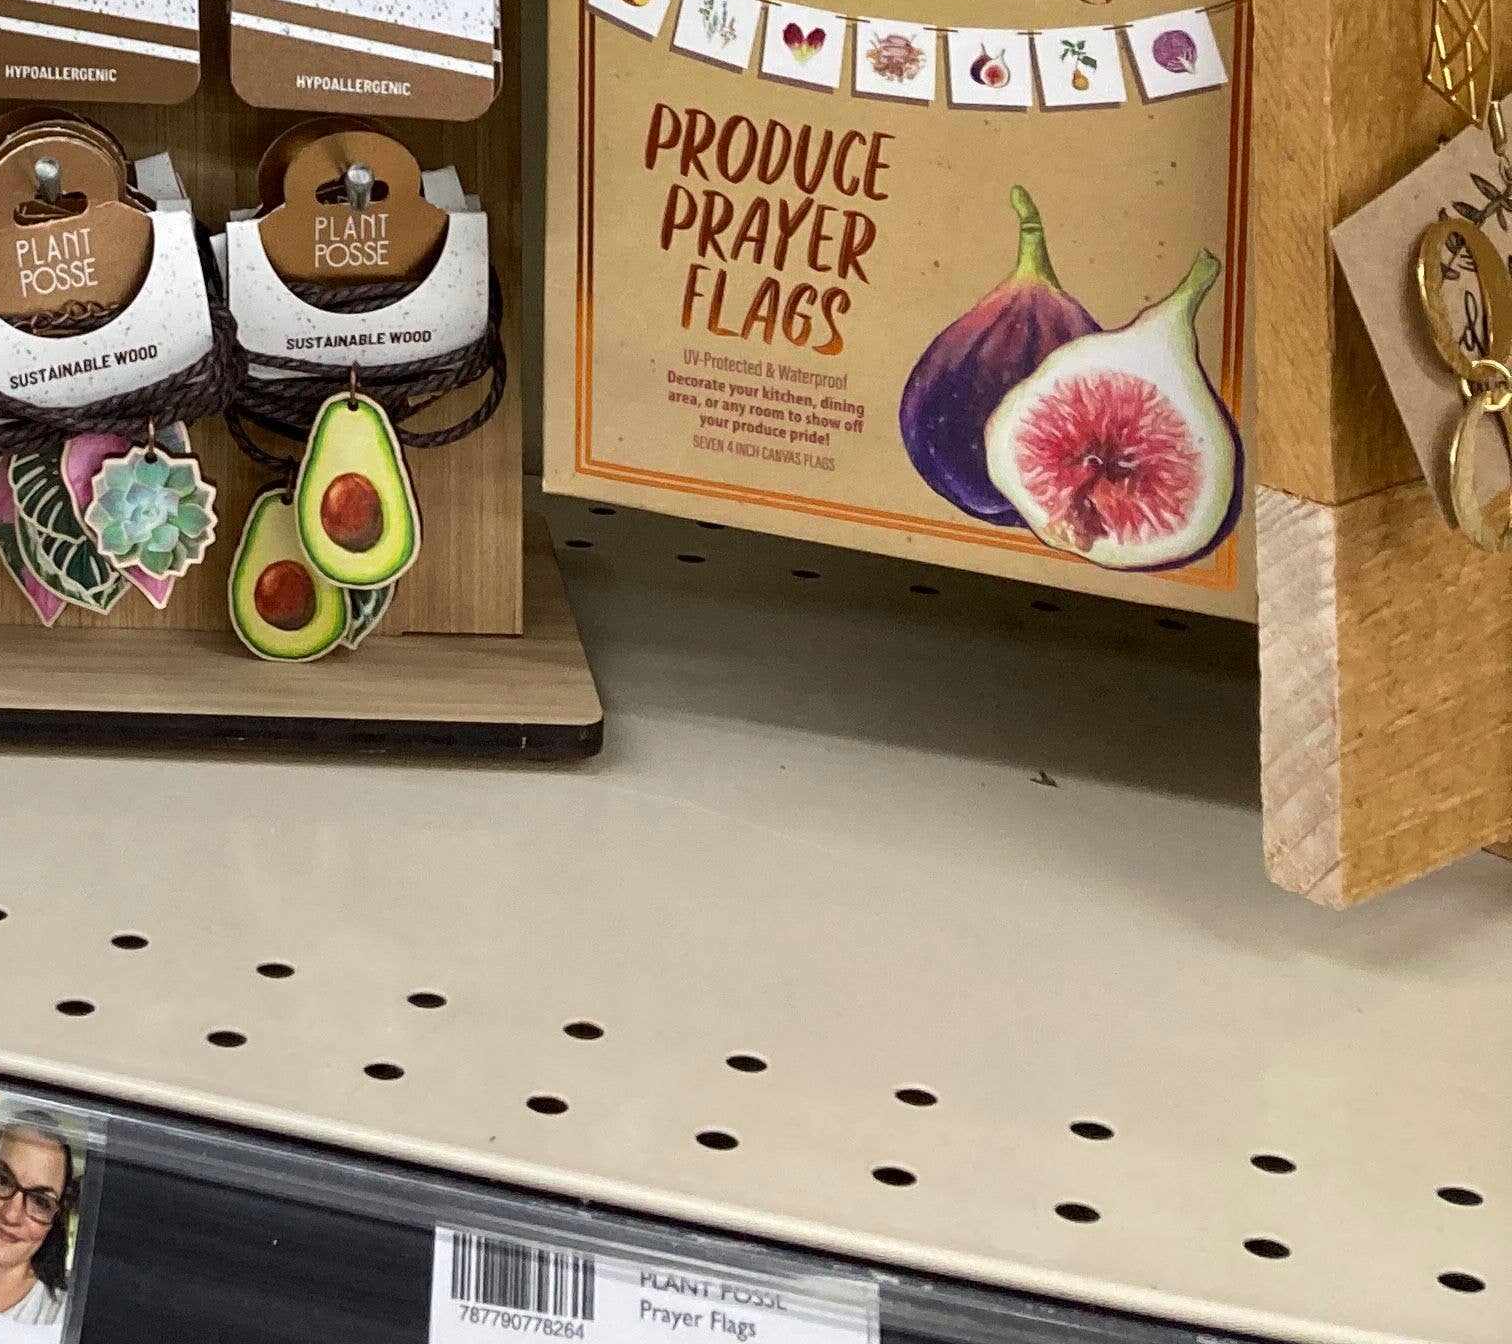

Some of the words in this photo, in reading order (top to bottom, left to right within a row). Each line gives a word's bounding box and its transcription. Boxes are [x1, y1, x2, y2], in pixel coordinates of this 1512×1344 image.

[4, 64, 118, 82] HYPOALLERGENIC
[295, 74, 412, 96] HYPOALLERGENIC
[644, 102, 897, 201] PRODUCE
[15, 228, 92, 266] PLANT
[315, 213, 390, 242] PLANT
[660, 183, 878, 285] PRAYER
[315, 240, 390, 268] POSSE
[20, 258, 100, 297] POSSE
[679, 263, 852, 356] FLAGS
[286, 332, 386, 351] SUSTAINABLE
[389, 329, 432, 345] WOOD
[9, 361, 112, 390] SUSTAINABLE
[114, 344, 159, 369] WOOD
[683, 348, 763, 378] UV-Protected
[765, 362, 776, 379] &
[777, 364, 849, 392] Waterproof
[666, 369, 727, 394] Decorate
[728, 383, 760, 401] your
[761, 385, 818, 410] kitchen,
[819, 396, 866, 419] dining
[667, 389, 702, 409] area,
[704, 396, 719, 409] or
[721, 400, 746, 417] any
[748, 405, 785, 422] room
[787, 410, 804, 424] to
[805, 413, 842, 431] show
[843, 419, 865, 434] off
[698, 413, 730, 430] your
[731, 419, 788, 440] produce
[789, 427, 830, 447] pride!
[692, 433, 725, 454] SEVEN
[726, 441, 735, 455] 4
[735, 442, 760, 460] INCH
[761, 446, 802, 467] CANVAS
[802, 455, 836, 472] FLAGS
[457, 1303, 586, 1341] 787790778264
[640, 1299, 704, 1331] Prayer
[710, 1310, 758, 1343] Flags
